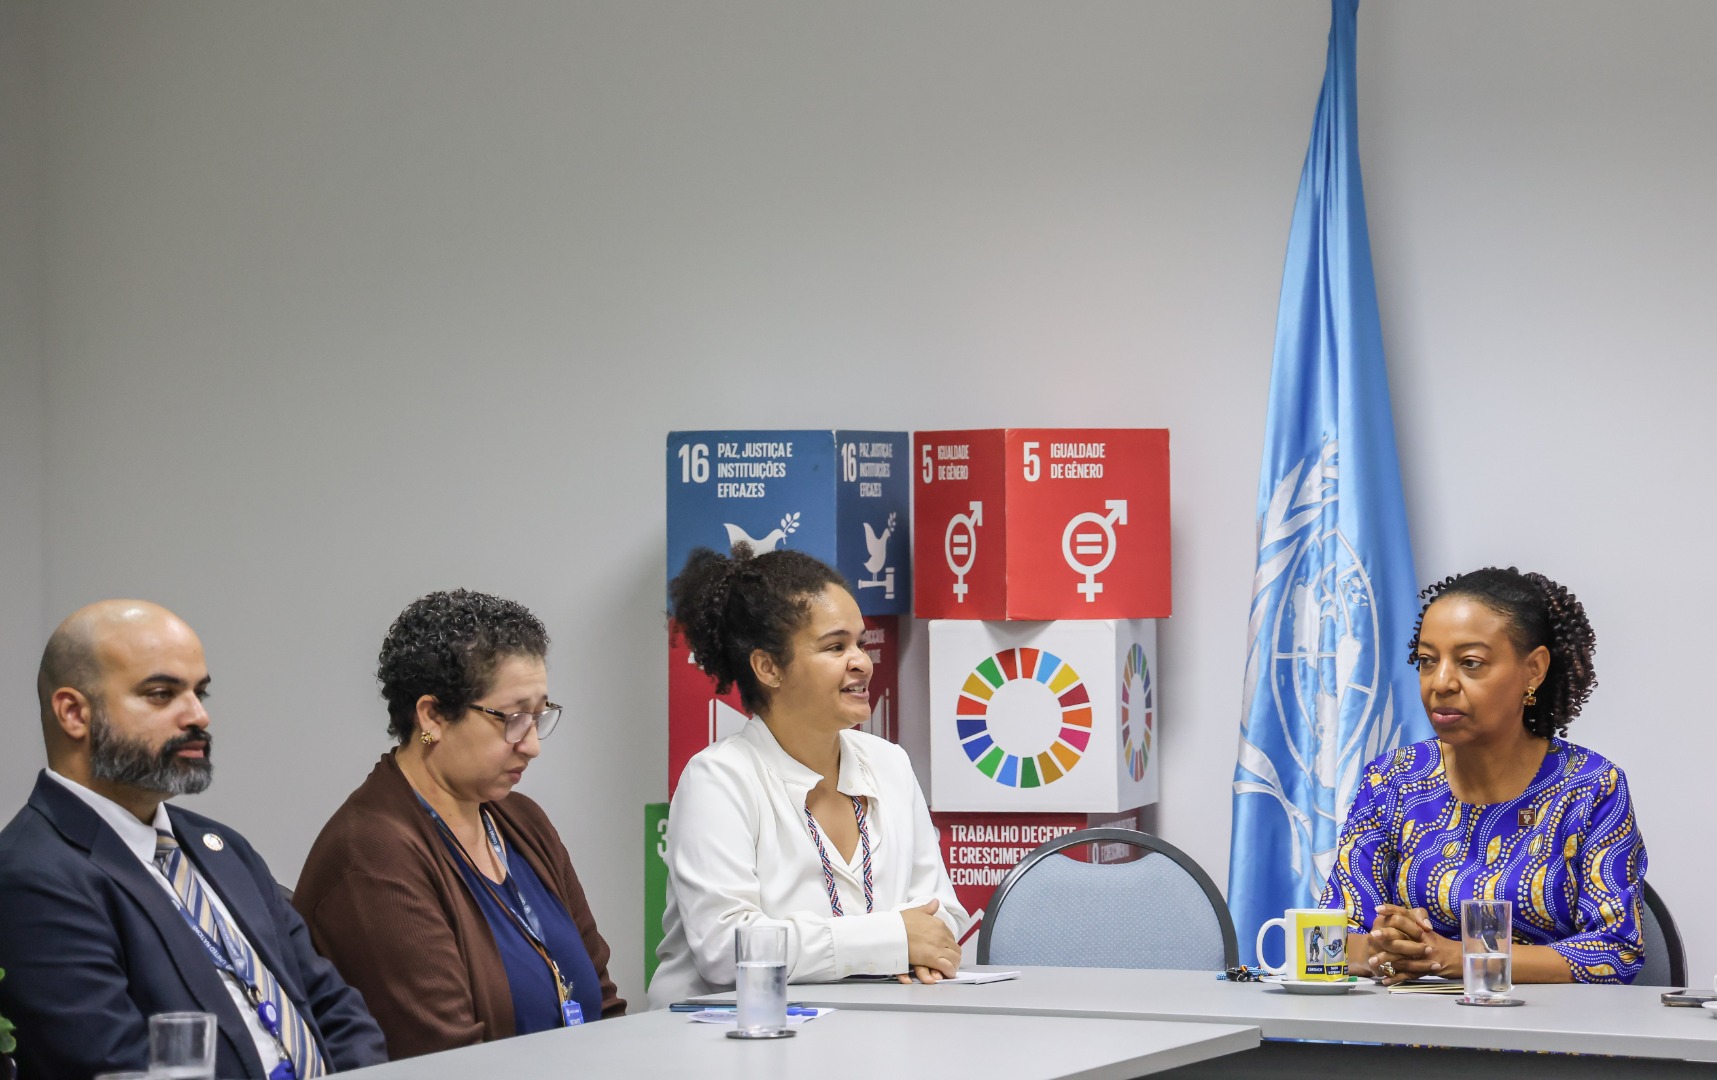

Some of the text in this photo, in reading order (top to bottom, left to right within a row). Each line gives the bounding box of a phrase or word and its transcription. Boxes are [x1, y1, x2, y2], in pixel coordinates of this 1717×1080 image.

[717, 442, 793, 459] PAZ, JUSTIÇA E
[937, 444, 970, 460] IGUALDADE
[1050, 442, 1106, 459] IGUALDADE
[678, 443, 710, 483] 16
[717, 460, 786, 479] INSTITUIÇÕES
[841, 442, 857, 482] 16
[922, 444, 933, 484] 5
[937, 462, 969, 480] DE GÊNERO
[1023, 441, 1040, 482] 5
[1050, 461, 1104, 479] DE GÊNERO
[717, 482, 765, 498] EFICAZES
[950, 825, 1019, 843] TRABALHO
[949, 846, 1036, 865] E CRESCIMEN
[191, 924, 212, 949] NATIONS
[209, 945, 228, 965] UNITED
